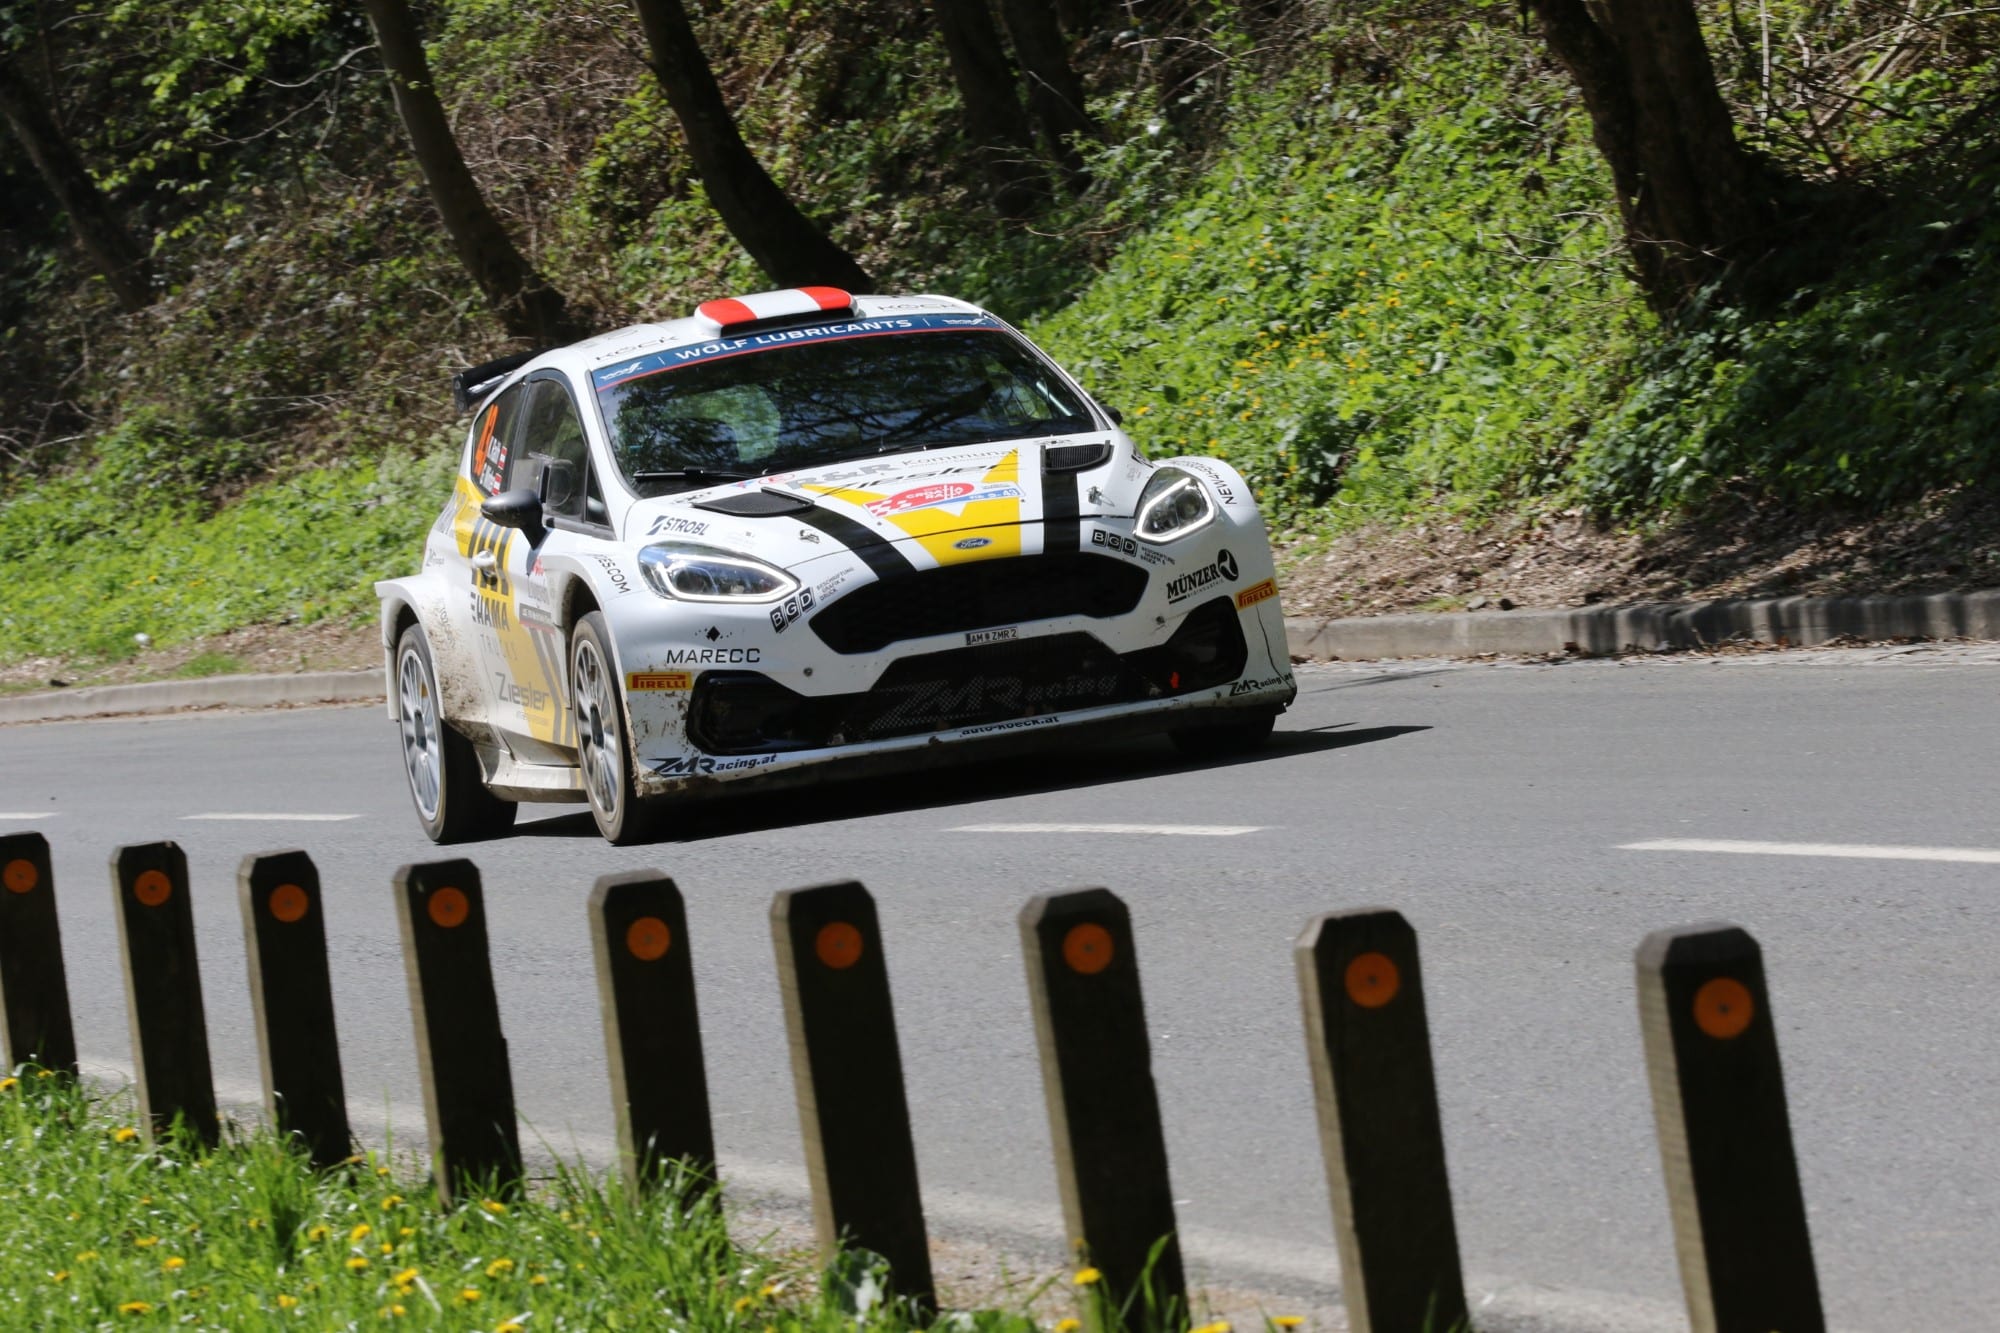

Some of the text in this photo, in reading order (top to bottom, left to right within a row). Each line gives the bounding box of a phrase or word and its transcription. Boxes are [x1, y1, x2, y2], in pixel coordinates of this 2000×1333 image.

[675, 318, 912, 360] WOLF LUBRICANTS
[663, 517, 710, 536] STROBL
[959, 538, 985, 549] Ford
[1093, 530, 1137, 555] BGD
[1166, 563, 1220, 599] MÜNZER
[1238, 582, 1274, 608] PIRELLI
[770, 588, 814, 632] BGD
[971, 628, 1017, 643] AM ZMR 2
[666, 648, 761, 664] MARECC
[632, 674, 687, 689] PIRELLI
